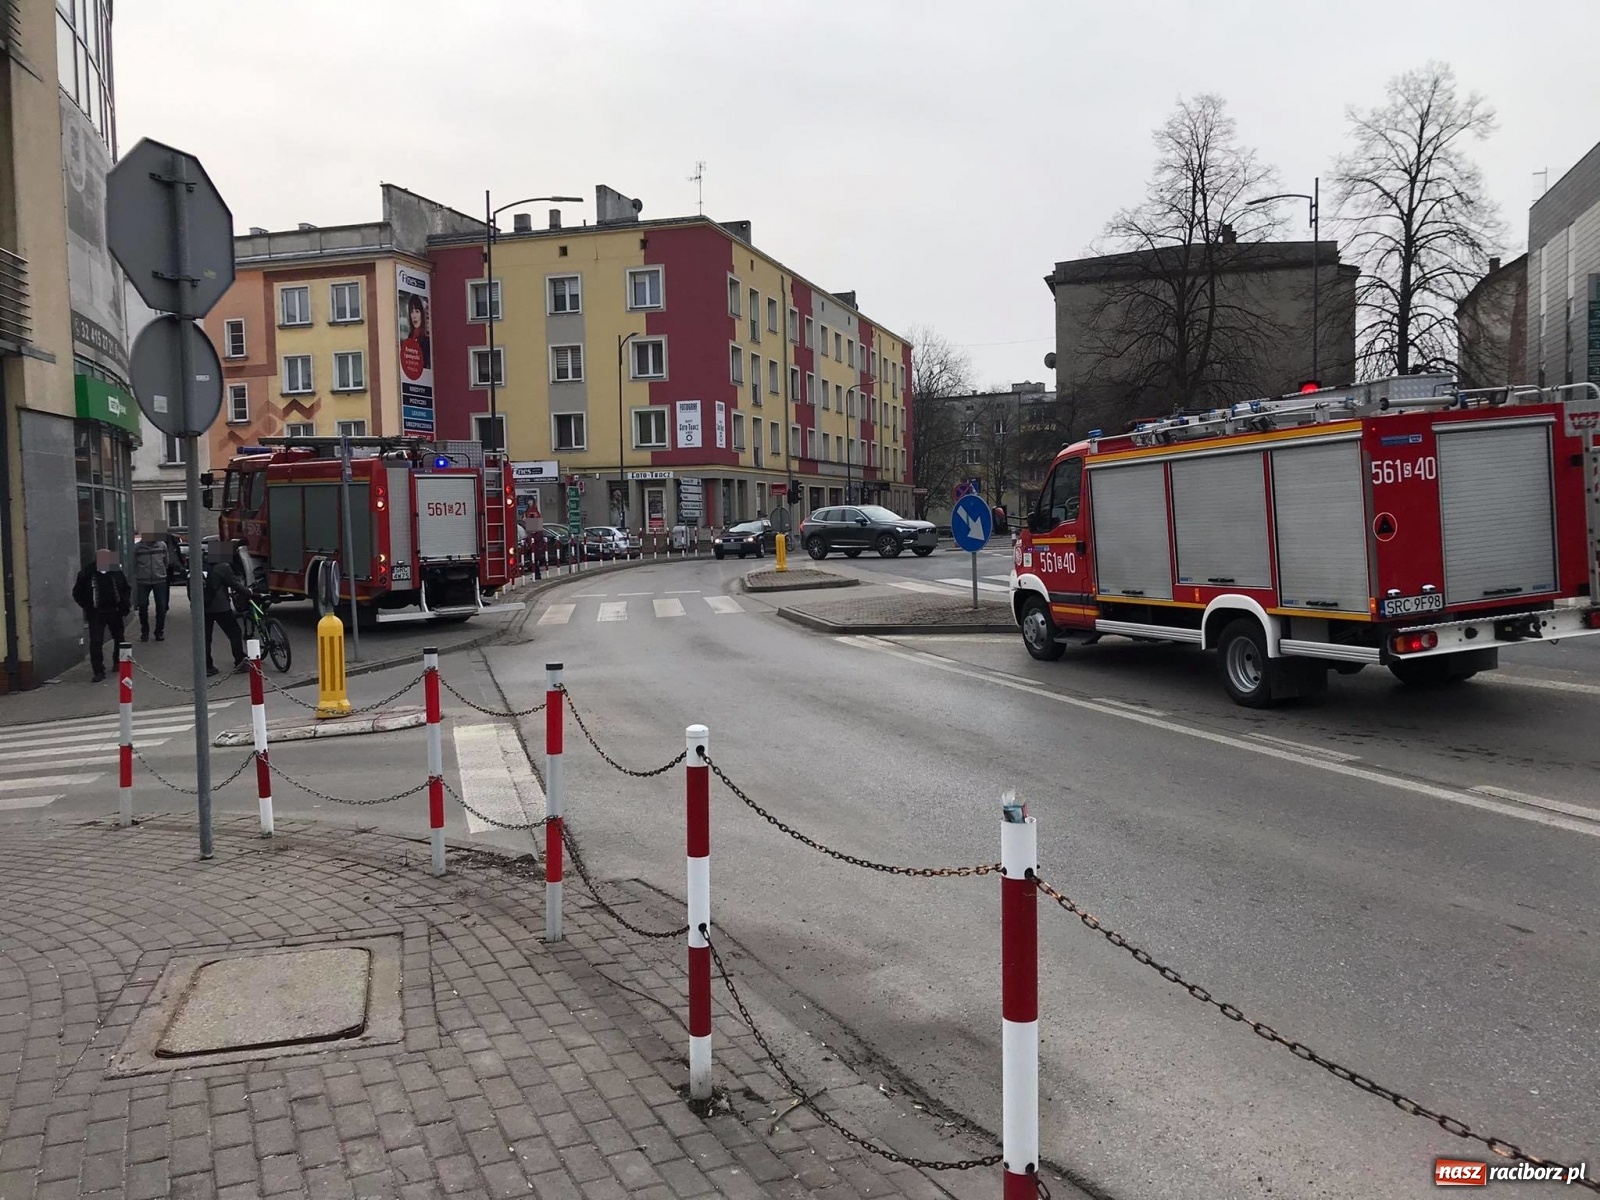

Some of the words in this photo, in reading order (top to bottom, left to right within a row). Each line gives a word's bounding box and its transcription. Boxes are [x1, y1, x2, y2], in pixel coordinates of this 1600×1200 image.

[81, 322, 90, 341] 32
[91, 328, 101, 347] 415
[1386, 599, 1411, 614] SRC
[1414, 595, 1440, 610] 9F98
